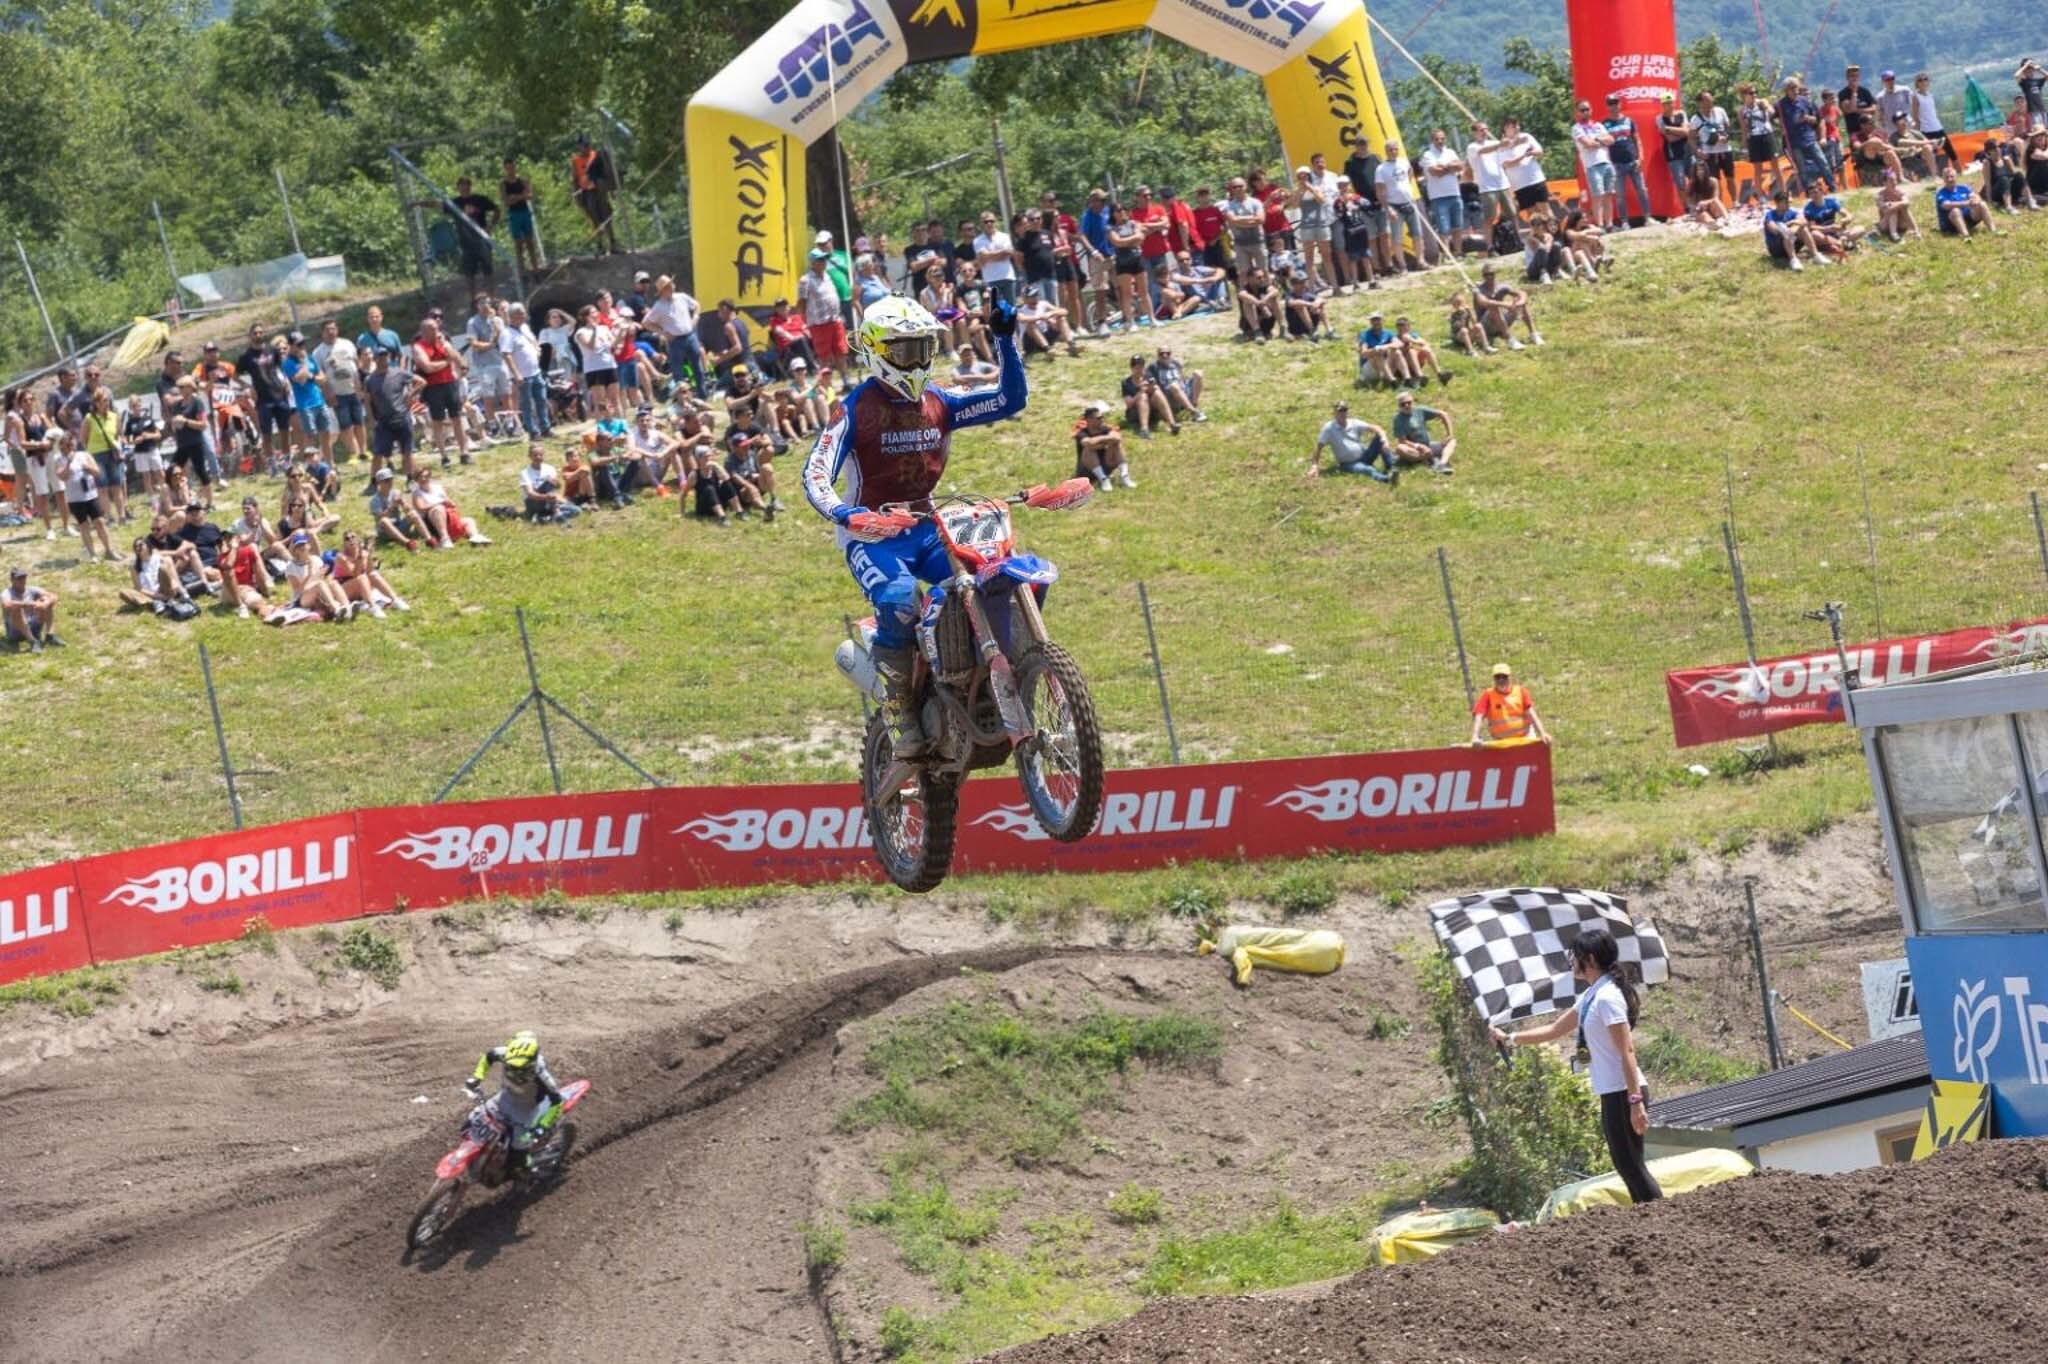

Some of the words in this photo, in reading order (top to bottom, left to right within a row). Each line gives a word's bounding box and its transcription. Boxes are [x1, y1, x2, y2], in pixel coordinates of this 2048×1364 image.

[1609, 66, 1640, 80] OFF
[1610, 54, 1642, 67] OUR
[1307, 49, 1364, 148] ROX
[728, 134, 783, 299] PROX
[954, 400, 999, 422] FIAMME
[881, 430, 922, 445] FIAMME
[1030, 785, 1237, 840] RILLI
[1294, 765, 1531, 821] BORILLI
[405, 813, 642, 870] BORILLI
[715, 807, 880, 851] BORI
[130, 835, 349, 913] BORILLI
[471, 850, 488, 866] 28
